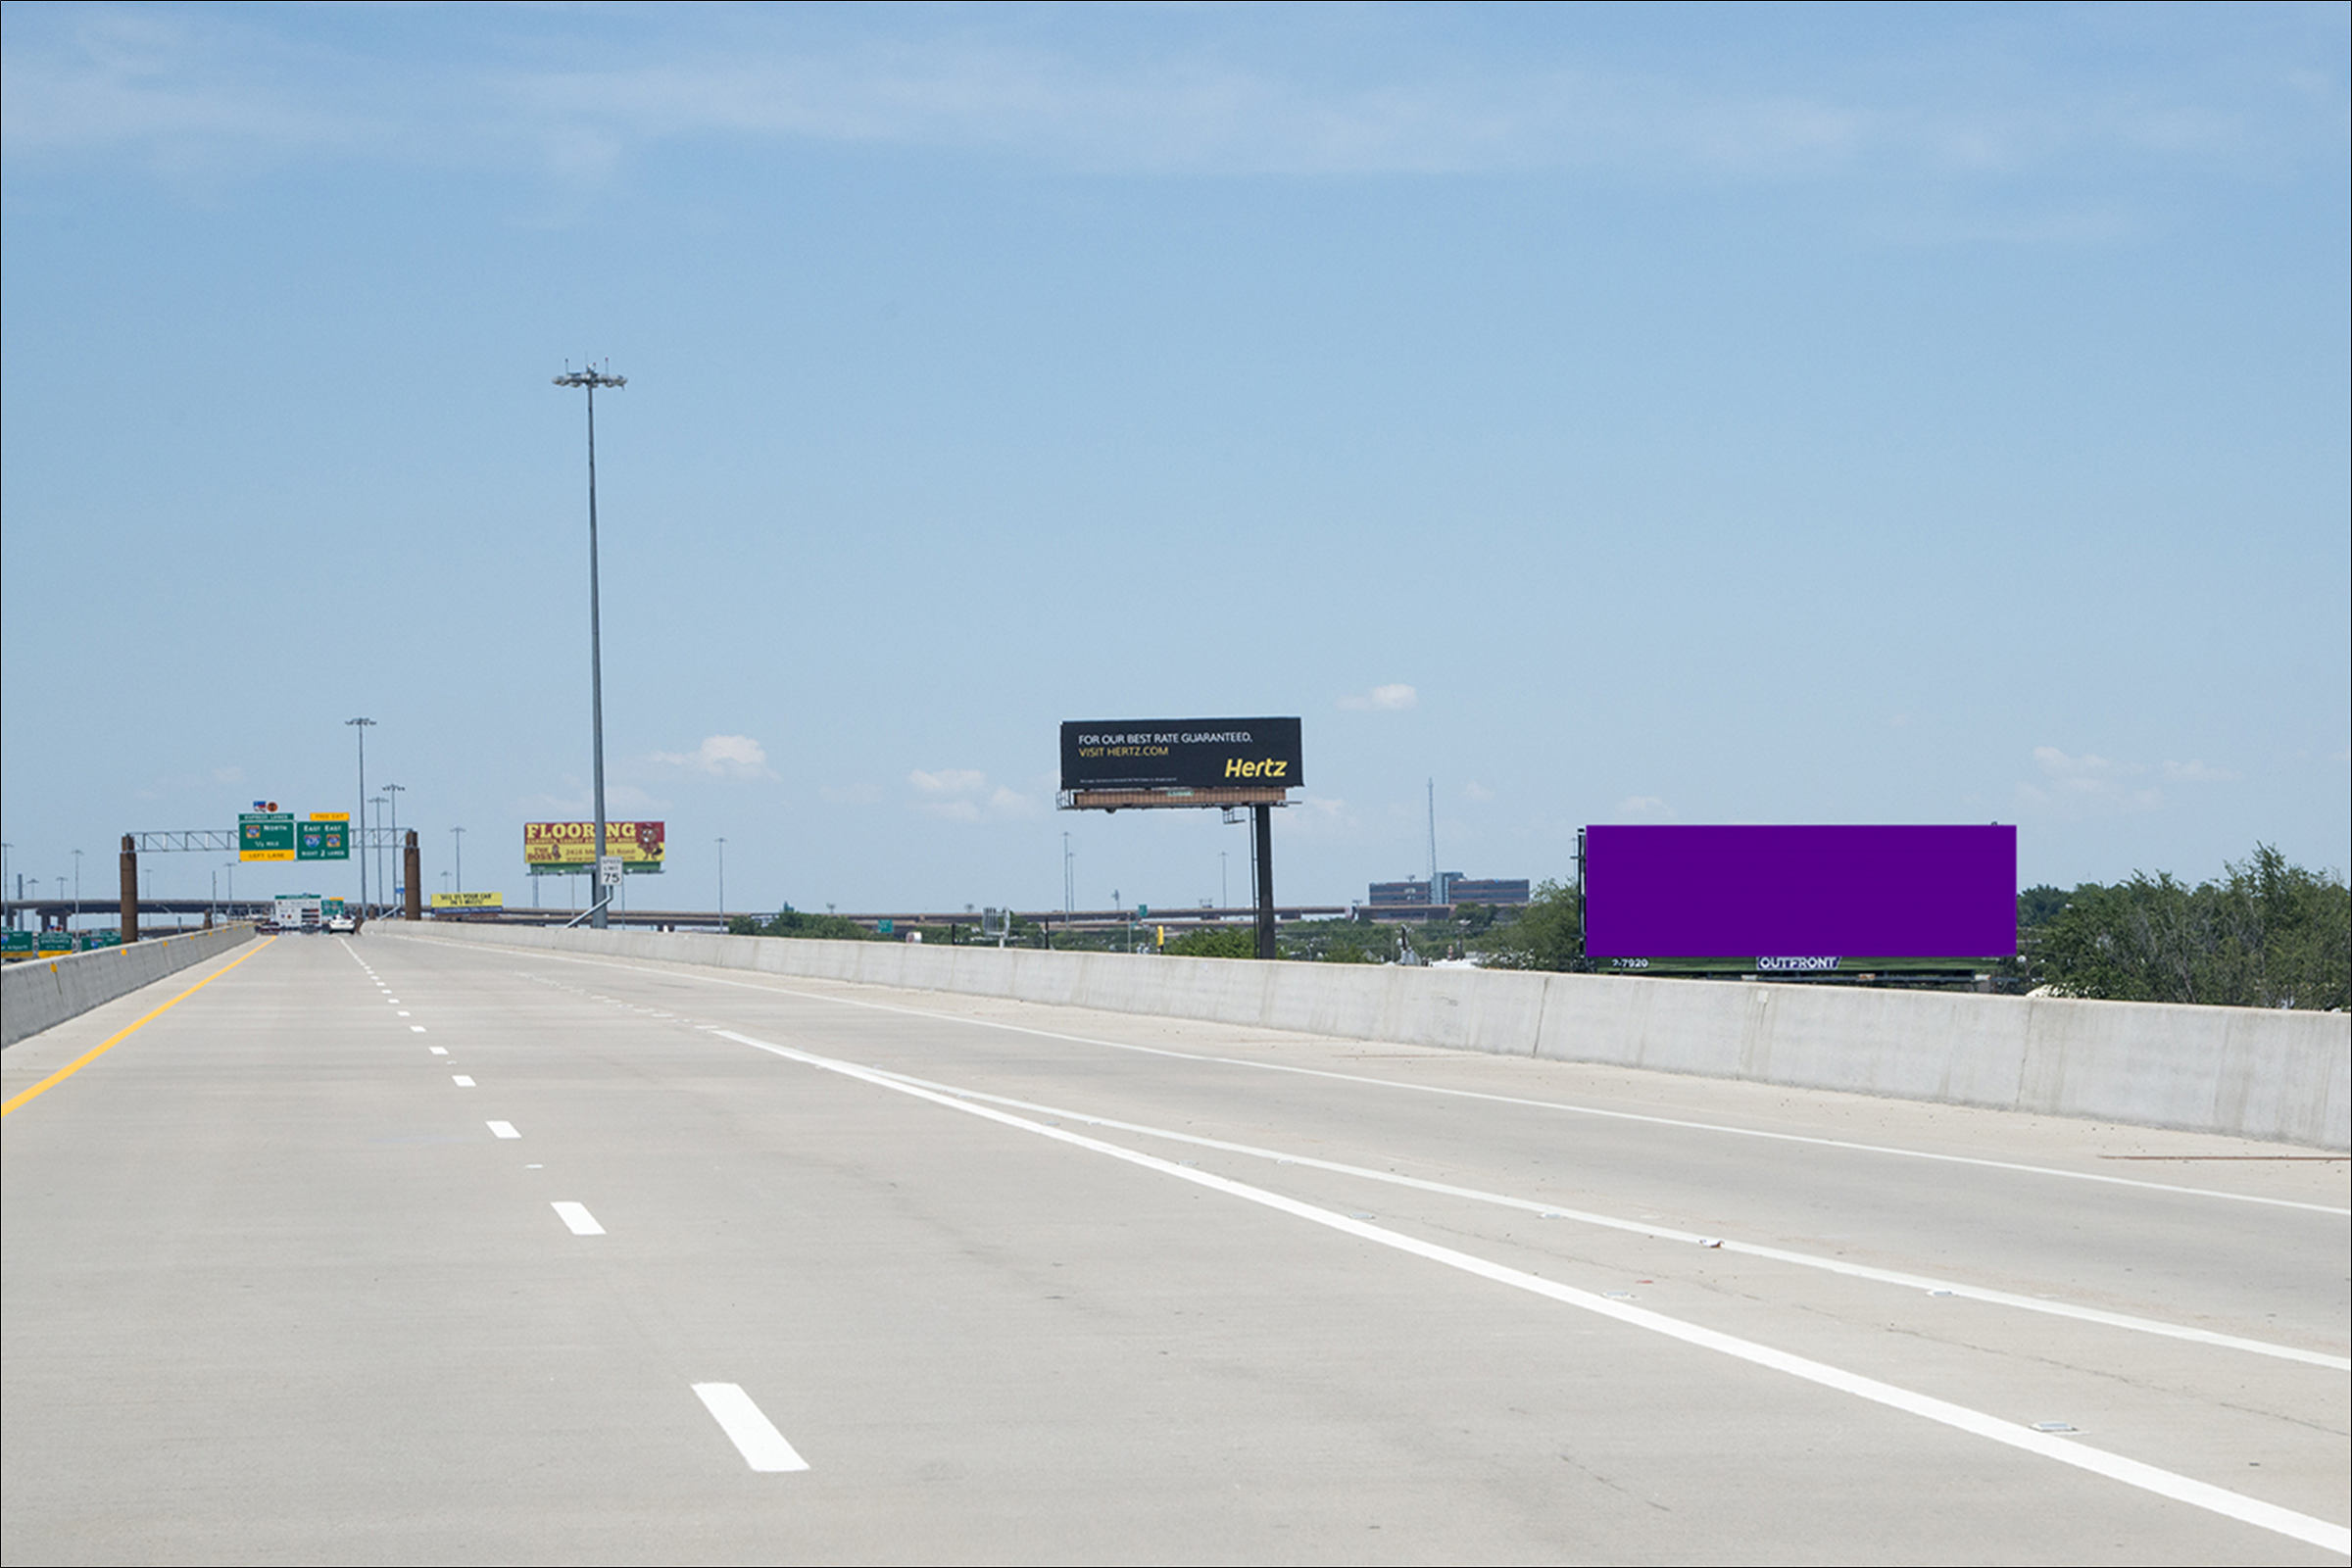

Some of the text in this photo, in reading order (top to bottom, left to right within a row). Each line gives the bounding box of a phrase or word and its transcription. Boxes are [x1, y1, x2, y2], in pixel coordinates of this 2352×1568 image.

[1078, 731, 1253, 745] FOR OUR BEST RATE GUARANTEED.
[1078, 746, 1169, 758] VISIT HERTZ.COM
[1224, 759, 1288, 777] Hertz
[526, 823, 636, 838] FLOORNG
[604, 872, 619, 883] 75
[1760, 956, 1837, 968] OUTFRONT
